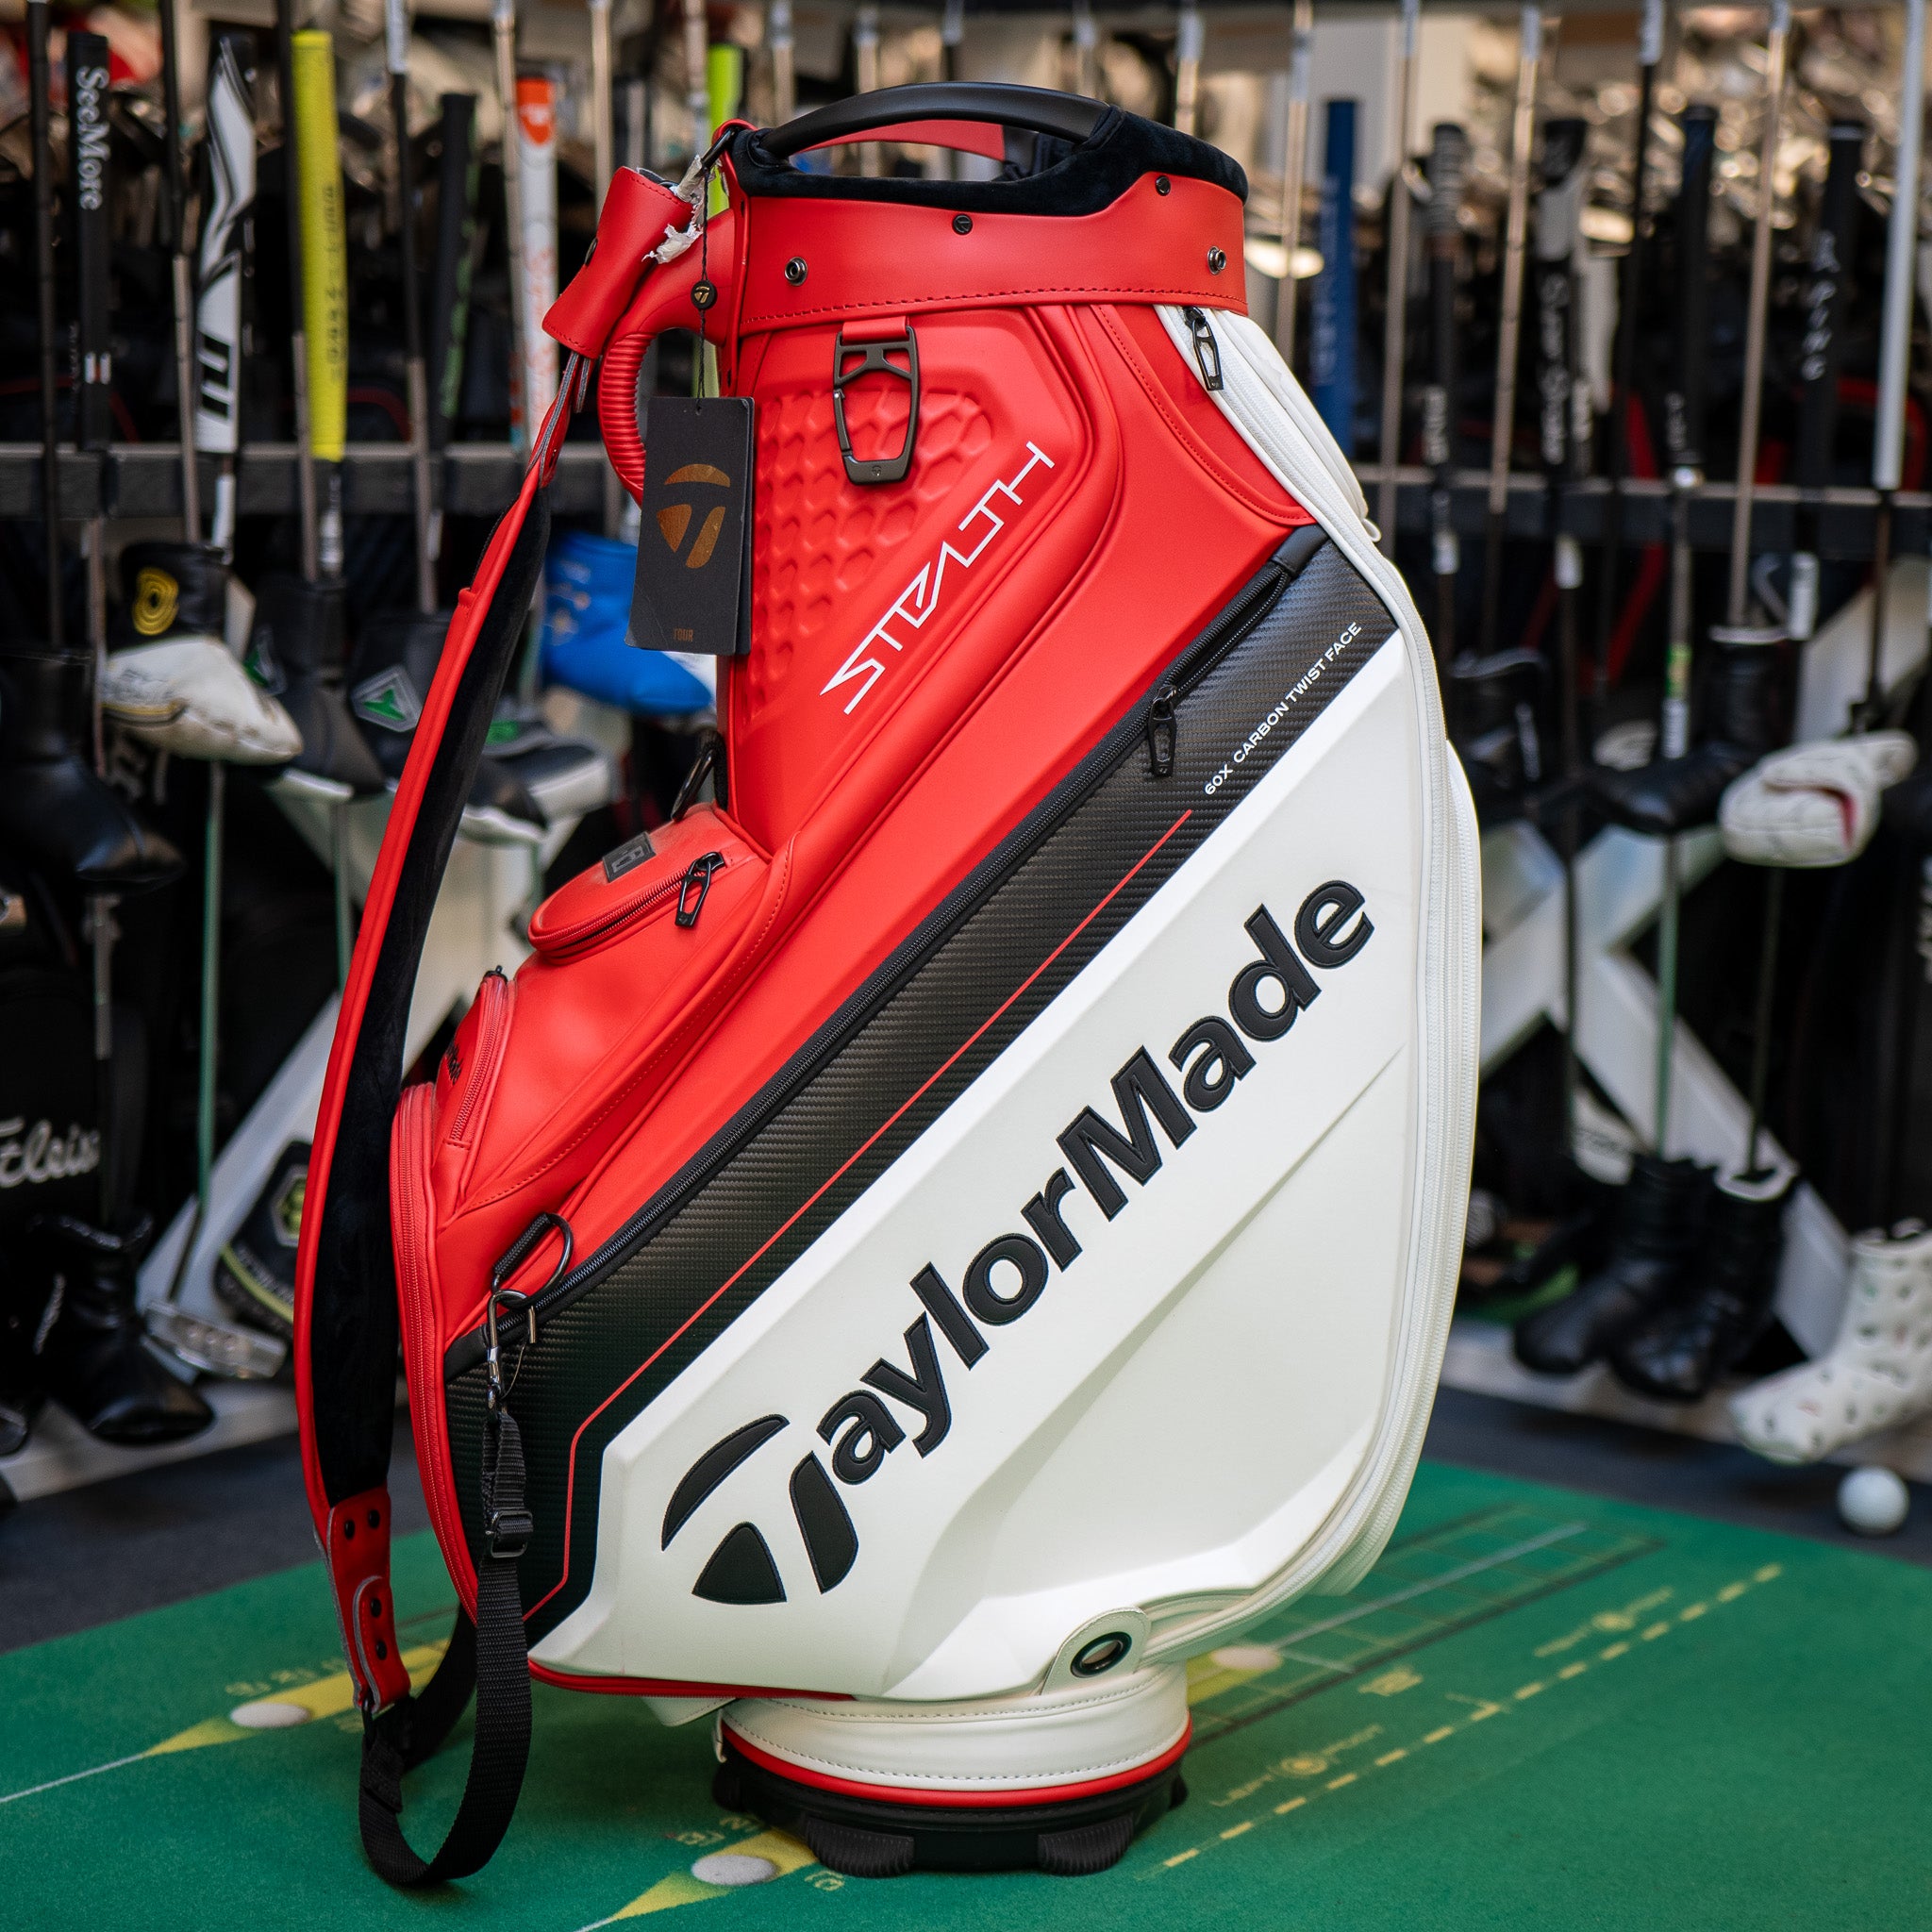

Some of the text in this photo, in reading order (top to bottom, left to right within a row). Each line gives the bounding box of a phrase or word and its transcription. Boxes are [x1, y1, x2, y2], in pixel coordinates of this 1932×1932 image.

[75, 65, 111, 211] SeeMore
[819, 441, 1056, 715] STEALTH
[1204, 622, 1362, 795] 60X CARBON TWIST FACE
[661, 879, 1375, 1605] TaylorMade
